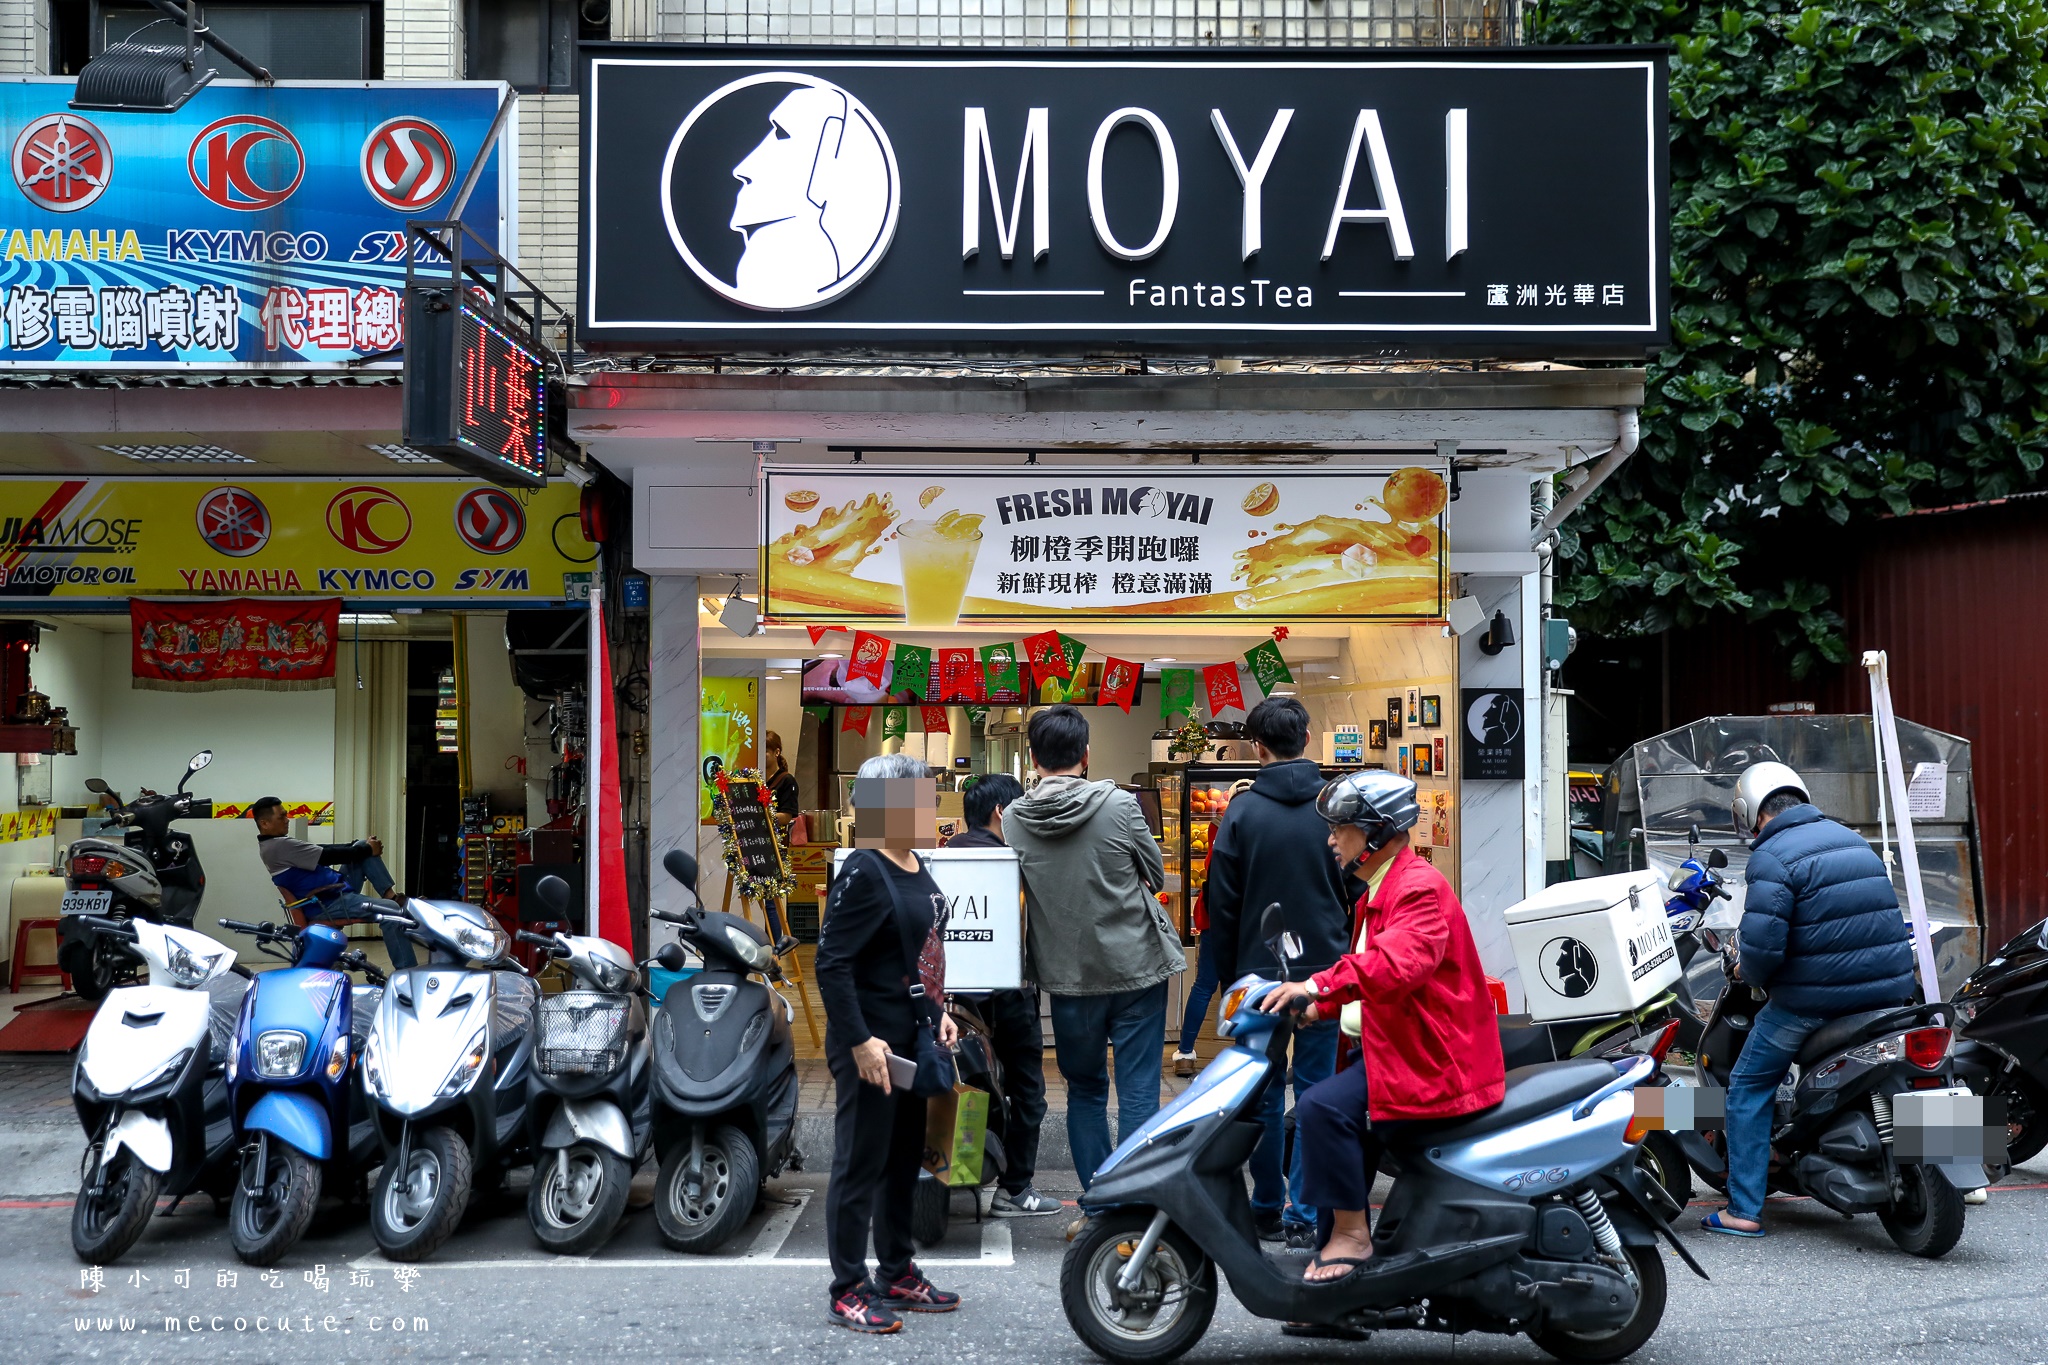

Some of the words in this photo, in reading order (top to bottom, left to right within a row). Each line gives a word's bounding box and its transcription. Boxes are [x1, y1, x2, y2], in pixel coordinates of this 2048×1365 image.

[962, 107, 1468, 262] MOYAI
[0, 229, 145, 262] AMAHA
[167, 230, 328, 262] KYMCO
[1129, 279, 1313, 308] FantasTea
[1486, 283, 1625, 307] 蘆洲光華店
[3, 284, 240, 351] 修電腦噴射
[259, 286, 405, 351] 代理總
[995, 487, 1094, 526] FRESH
[49, 518, 142, 546] MOSE
[1009, 535, 1200, 563] 柳橙季開跑囉
[13, 565, 101, 586] MOTOR
[102, 566, 138, 584] OIL
[178, 568, 303, 591] YAMAHA
[317, 568, 436, 591] KYMCO
[454, 568, 531, 592] SYM
[997, 572, 1098, 594] 新鮮現榨
[1111, 572, 1213, 594] 橙意滿滿
[62, 898, 109, 911] 939-KBY
[946, 895, 988, 920] YAI
[1637, 922, 1668, 956] MOYAI
